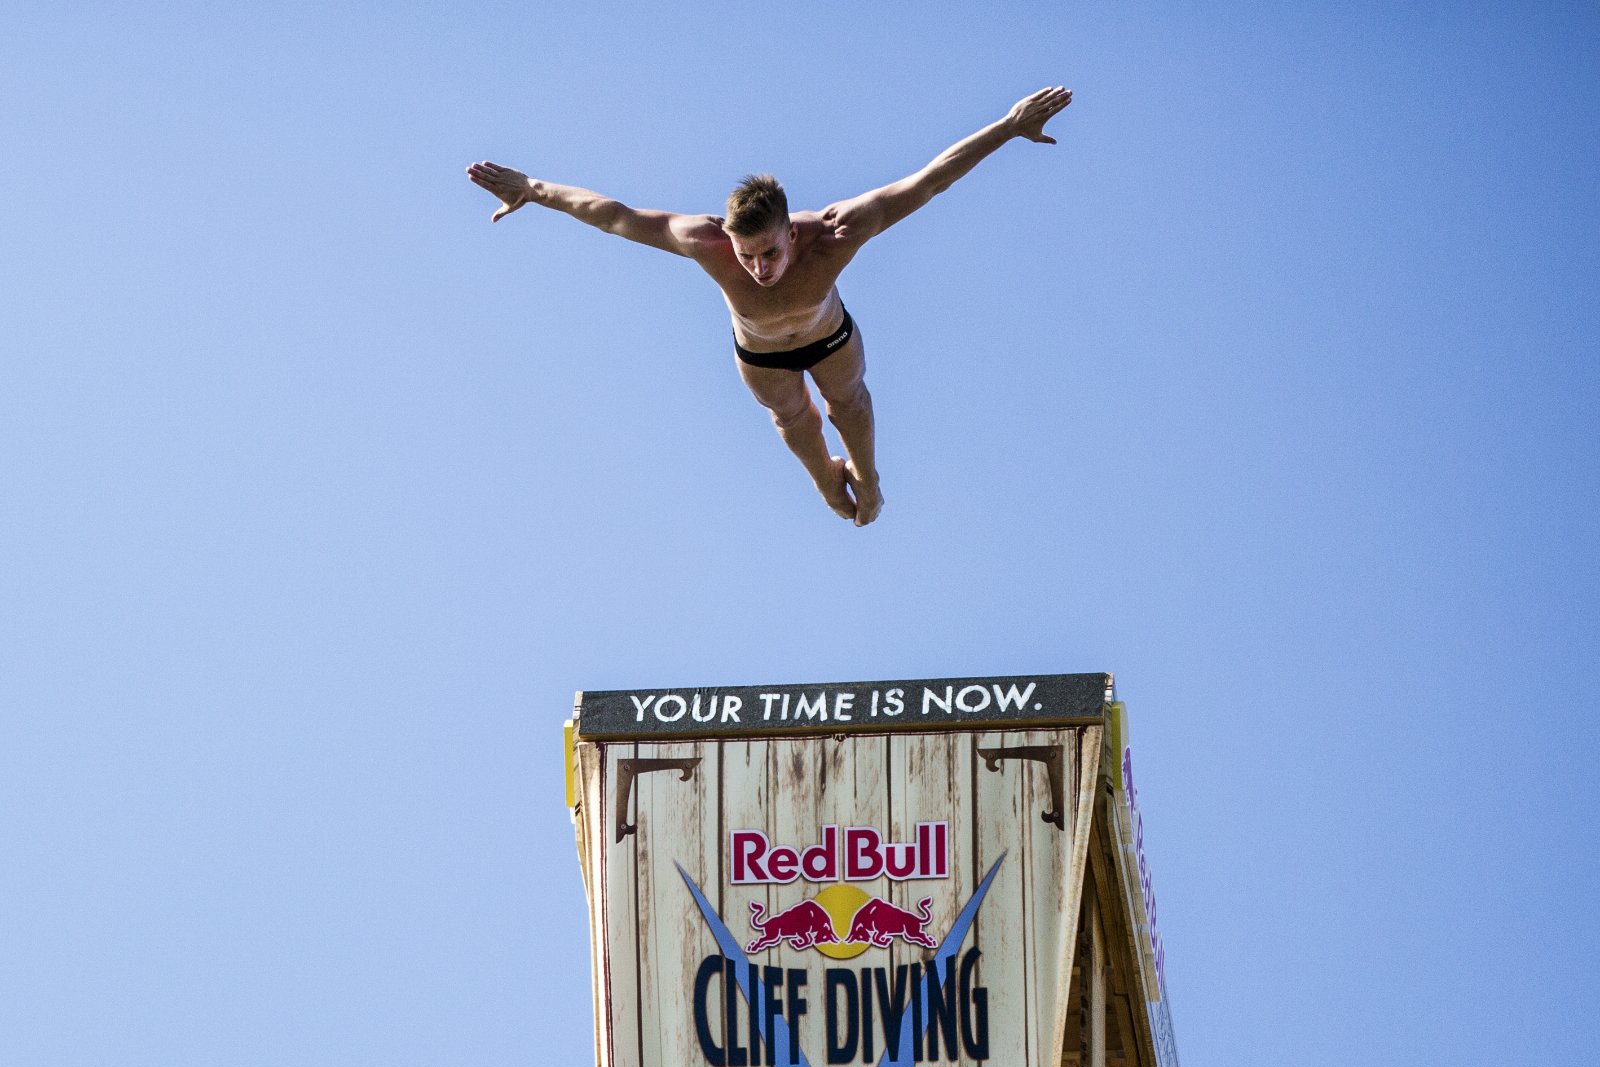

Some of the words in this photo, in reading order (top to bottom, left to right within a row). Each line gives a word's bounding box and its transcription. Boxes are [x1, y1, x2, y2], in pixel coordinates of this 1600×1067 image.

[630, 695, 742, 723] YOUR
[759, 692, 855, 721] TIME
[871, 688, 904, 717] IS
[922, 682, 1043, 715] NOW.
[733, 827, 836, 881] Red
[847, 824, 946, 878] Bull
[693, 954, 808, 1067] CLIFF
[826, 945, 990, 1065] DIVING
